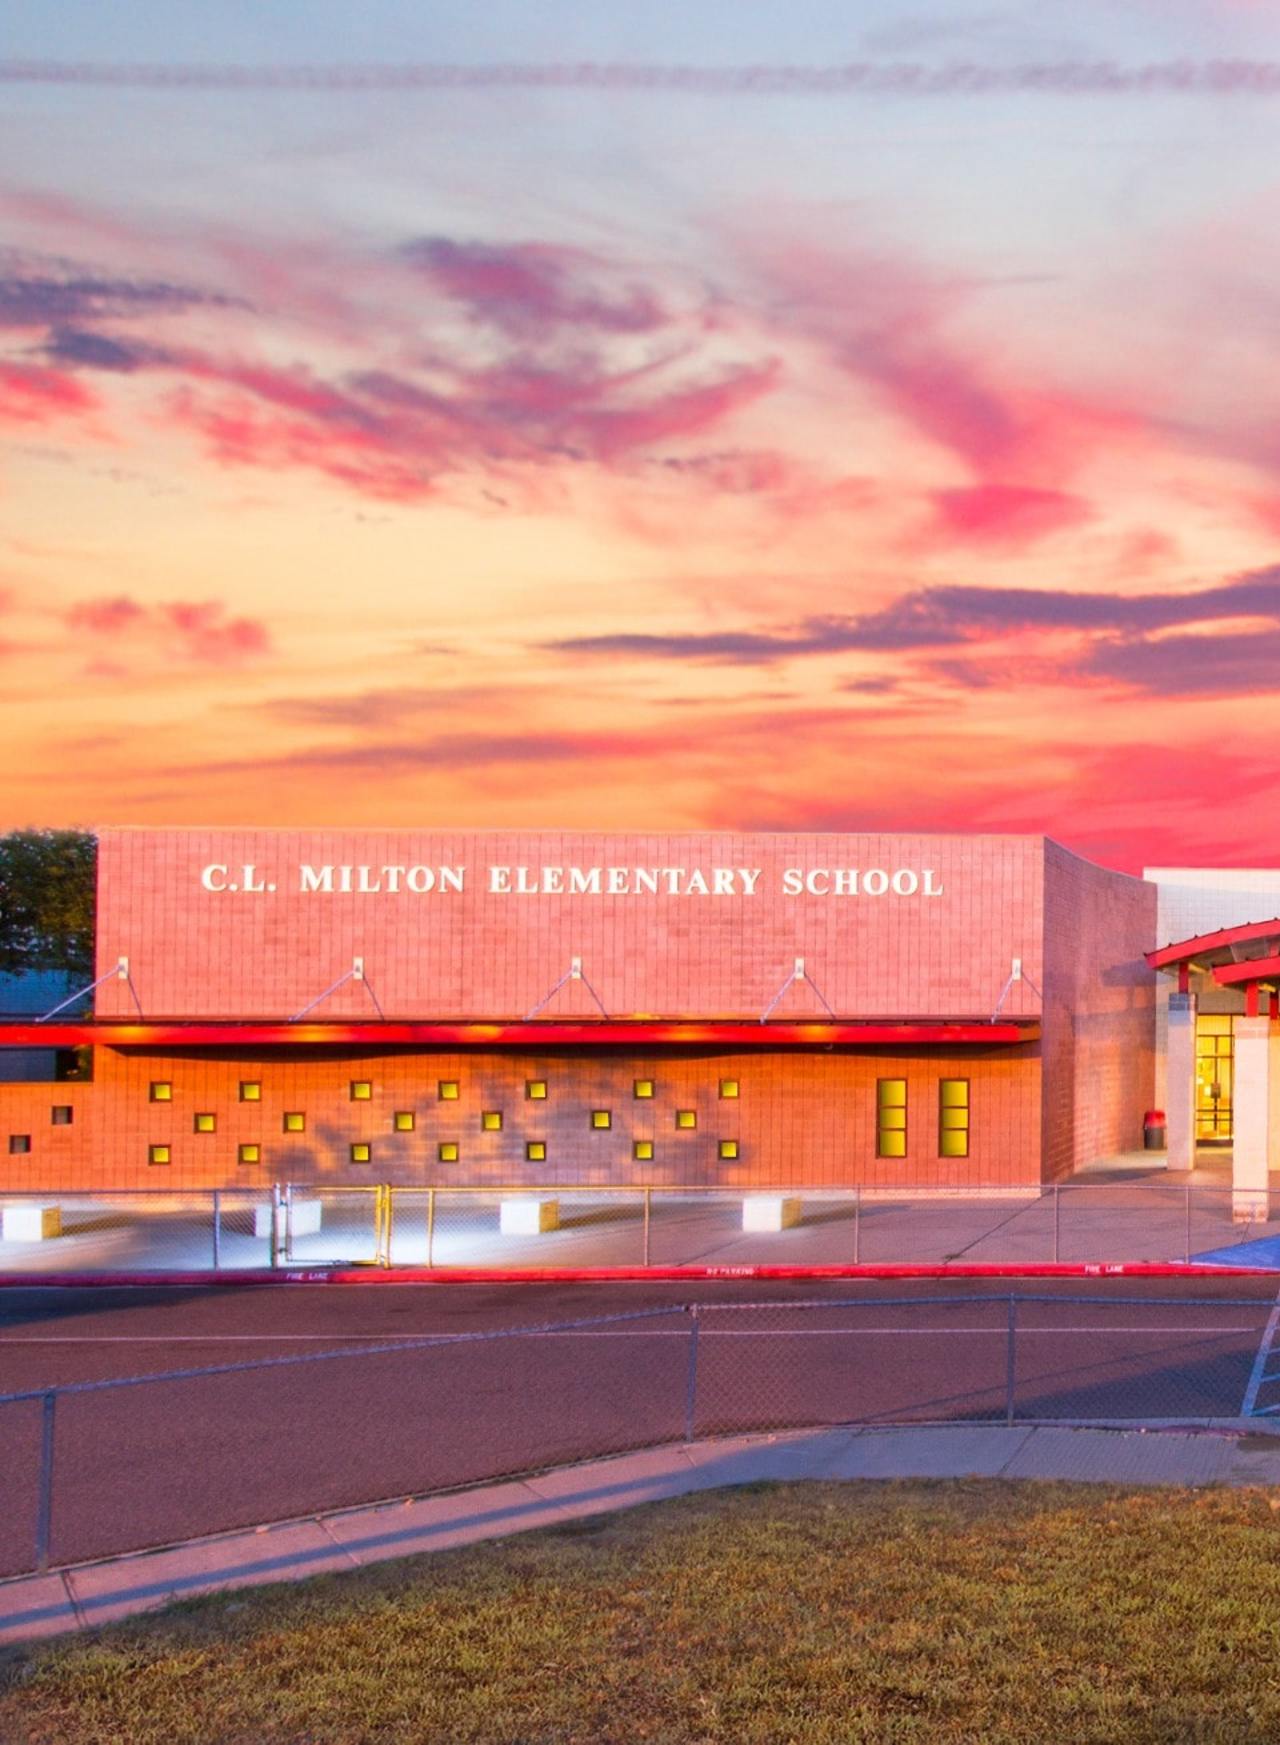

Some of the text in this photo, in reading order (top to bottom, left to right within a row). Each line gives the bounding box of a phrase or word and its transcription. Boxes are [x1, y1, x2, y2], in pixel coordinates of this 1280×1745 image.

[201, 864, 944, 896] C.L. MILTON ELEMENTARY SCHOOL
[1105, 1265, 1124, 1273] LANE
